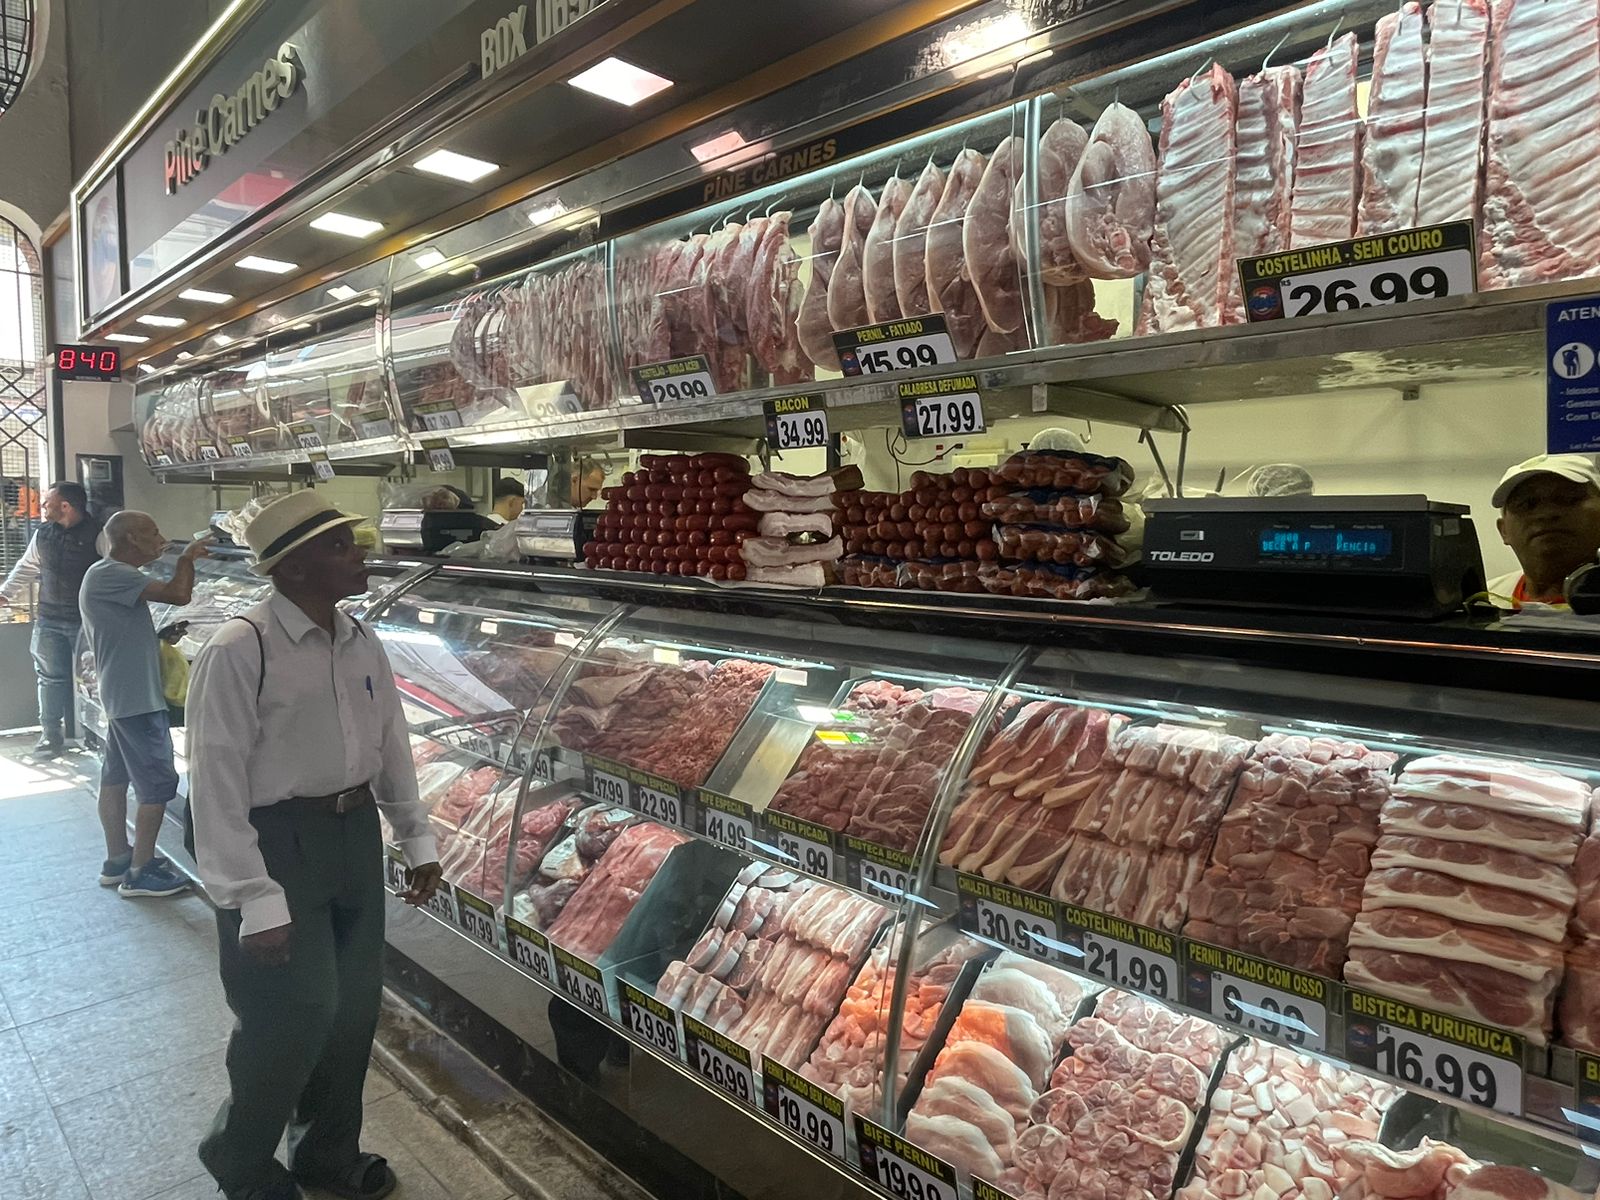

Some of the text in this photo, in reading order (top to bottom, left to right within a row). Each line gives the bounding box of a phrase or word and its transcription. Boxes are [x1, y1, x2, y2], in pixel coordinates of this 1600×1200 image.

[481, 5, 527, 80] BOX
[208, 41, 299, 156] Carnes
[751, 138, 838, 183] CARNES
[1255, 246, 1343, 277] COSTELINHA
[1353, 238, 1384, 262] SEM
[1388, 229, 1444, 255] COURO
[857, 329, 886, 343] PERNIL
[889, 320, 923, 337] FATIADO
[1558, 307, 1600, 322] ATEN
[653, 380, 708, 402] 2999
[775, 397, 809, 412] BACON
[899, 376, 977, 397] CALABRESA DEFUMADA
[1150, 551, 1215, 563] TOLEDO
[768, 813, 829, 844] PALETA PICADA
[848, 838, 885, 857] BISTECA
[958, 877, 990, 897] CHULETA
[992, 888, 1013, 904] SETE
[1023, 894, 1055, 917] PALETA
[1066, 906, 1172, 954] COSTELINHA TIRAS
[1086, 941, 1168, 1001] 21.99
[1189, 944, 1324, 999] PERNIL PICADO COM OSSO
[1222, 984, 1306, 1046] 9.99
[1351, 993, 1514, 1056] BISTECA PURURUCA
[715, 1035, 748, 1063] ESPECIAL
[1377, 1036, 1497, 1109] 16.99
[780, 1095, 833, 1152] 19.99
[863, 1122, 944, 1178] BIFE PERNIL
